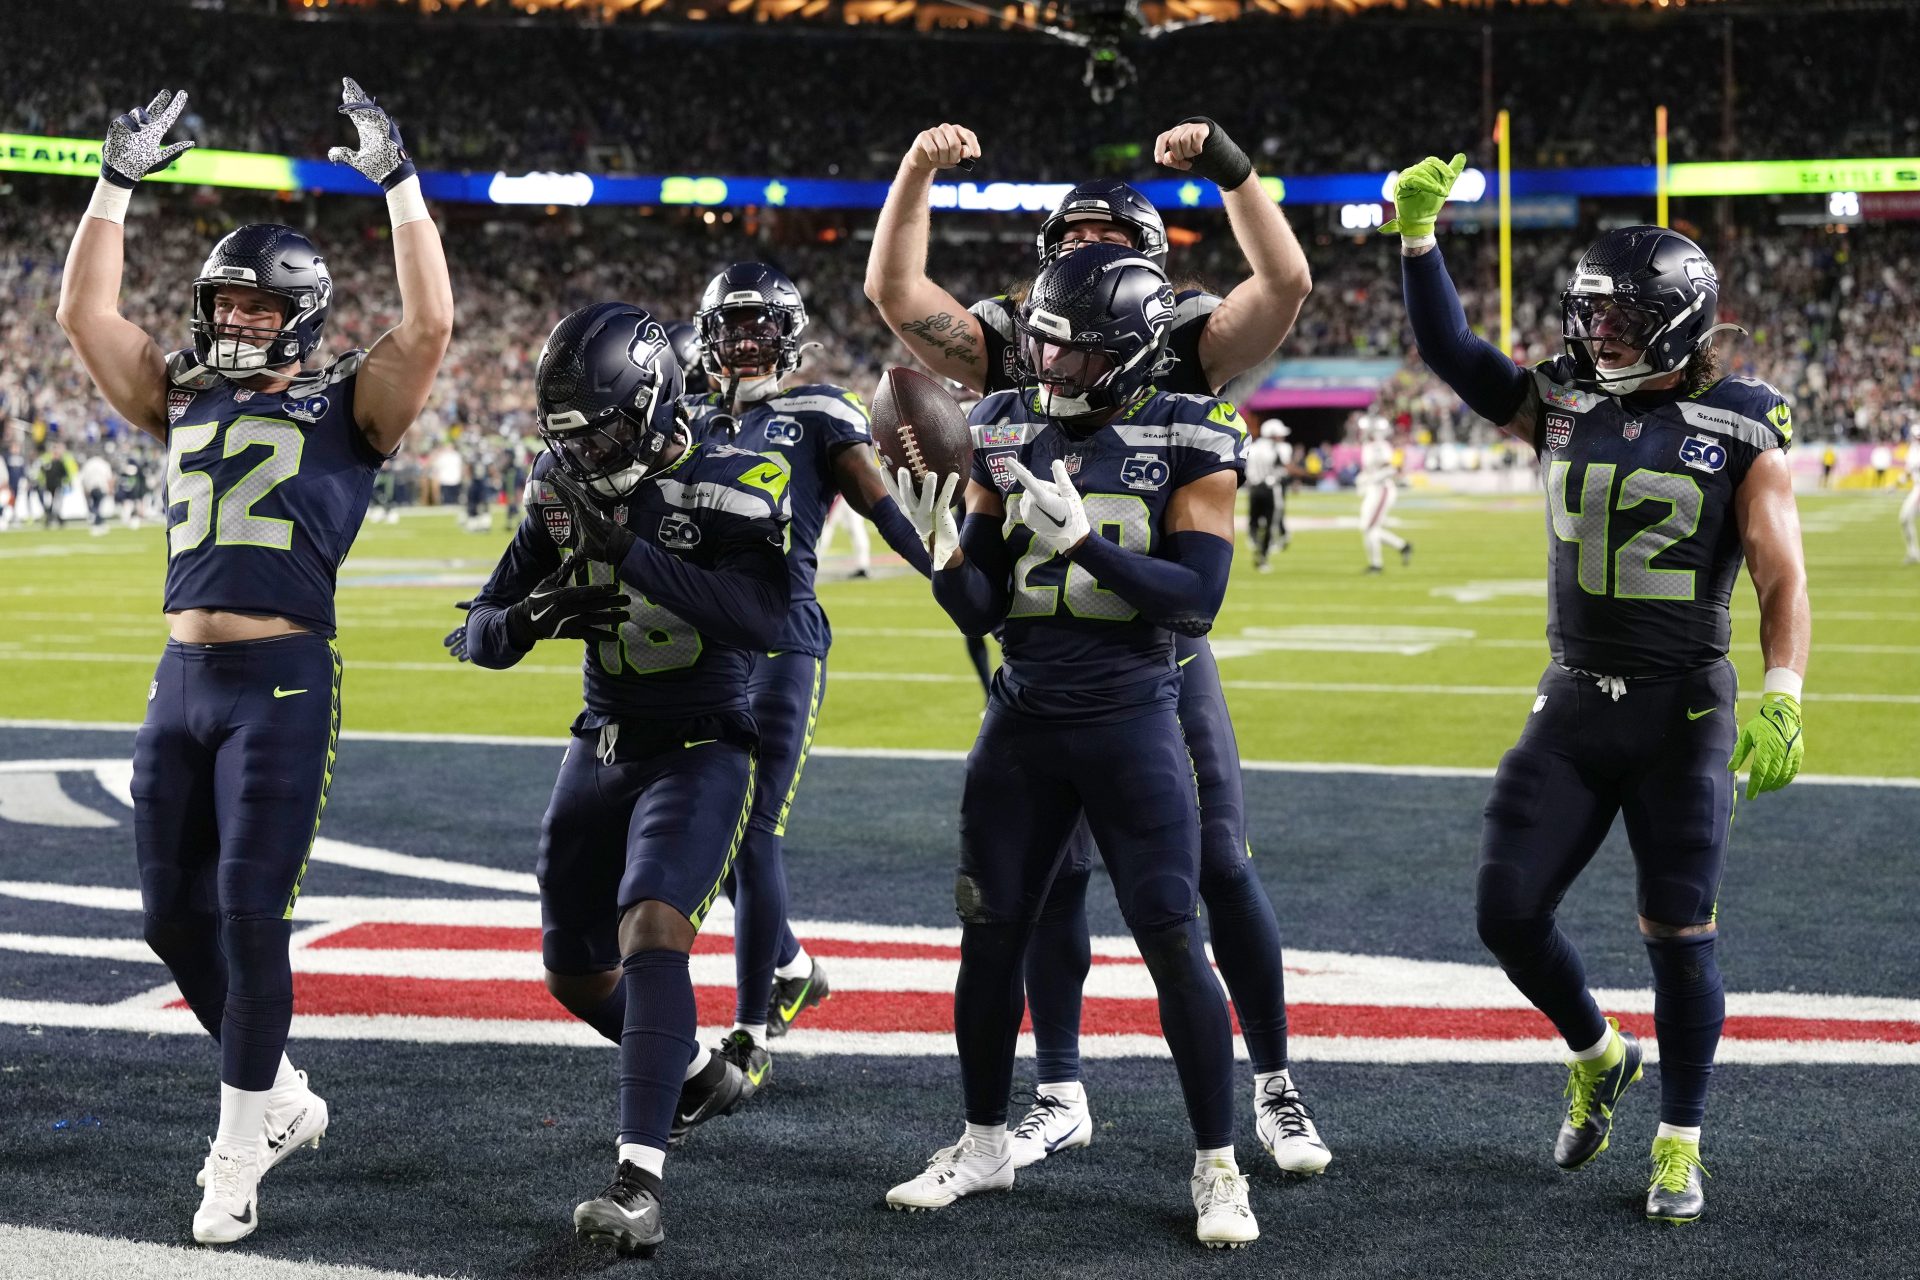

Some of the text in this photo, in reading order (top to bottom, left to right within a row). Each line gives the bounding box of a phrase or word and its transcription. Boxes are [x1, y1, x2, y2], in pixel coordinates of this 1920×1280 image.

[170, 393, 191, 401] USA
[1547, 417, 1570, 429] USA
[1697, 412, 1740, 429] SEAHAWKS
[765, 419, 803, 443] 50
[1547, 432, 1568, 445] 250
[989, 457, 1006, 467] US
[1679, 436, 1727, 472] 50
[1120, 457, 1170, 487] 50
[167, 415, 305, 558] 52
[545, 511, 569, 520] USA
[548, 526, 570, 536] 250
[658, 516, 701, 545] 50
[1548, 461, 1704, 600] 42
